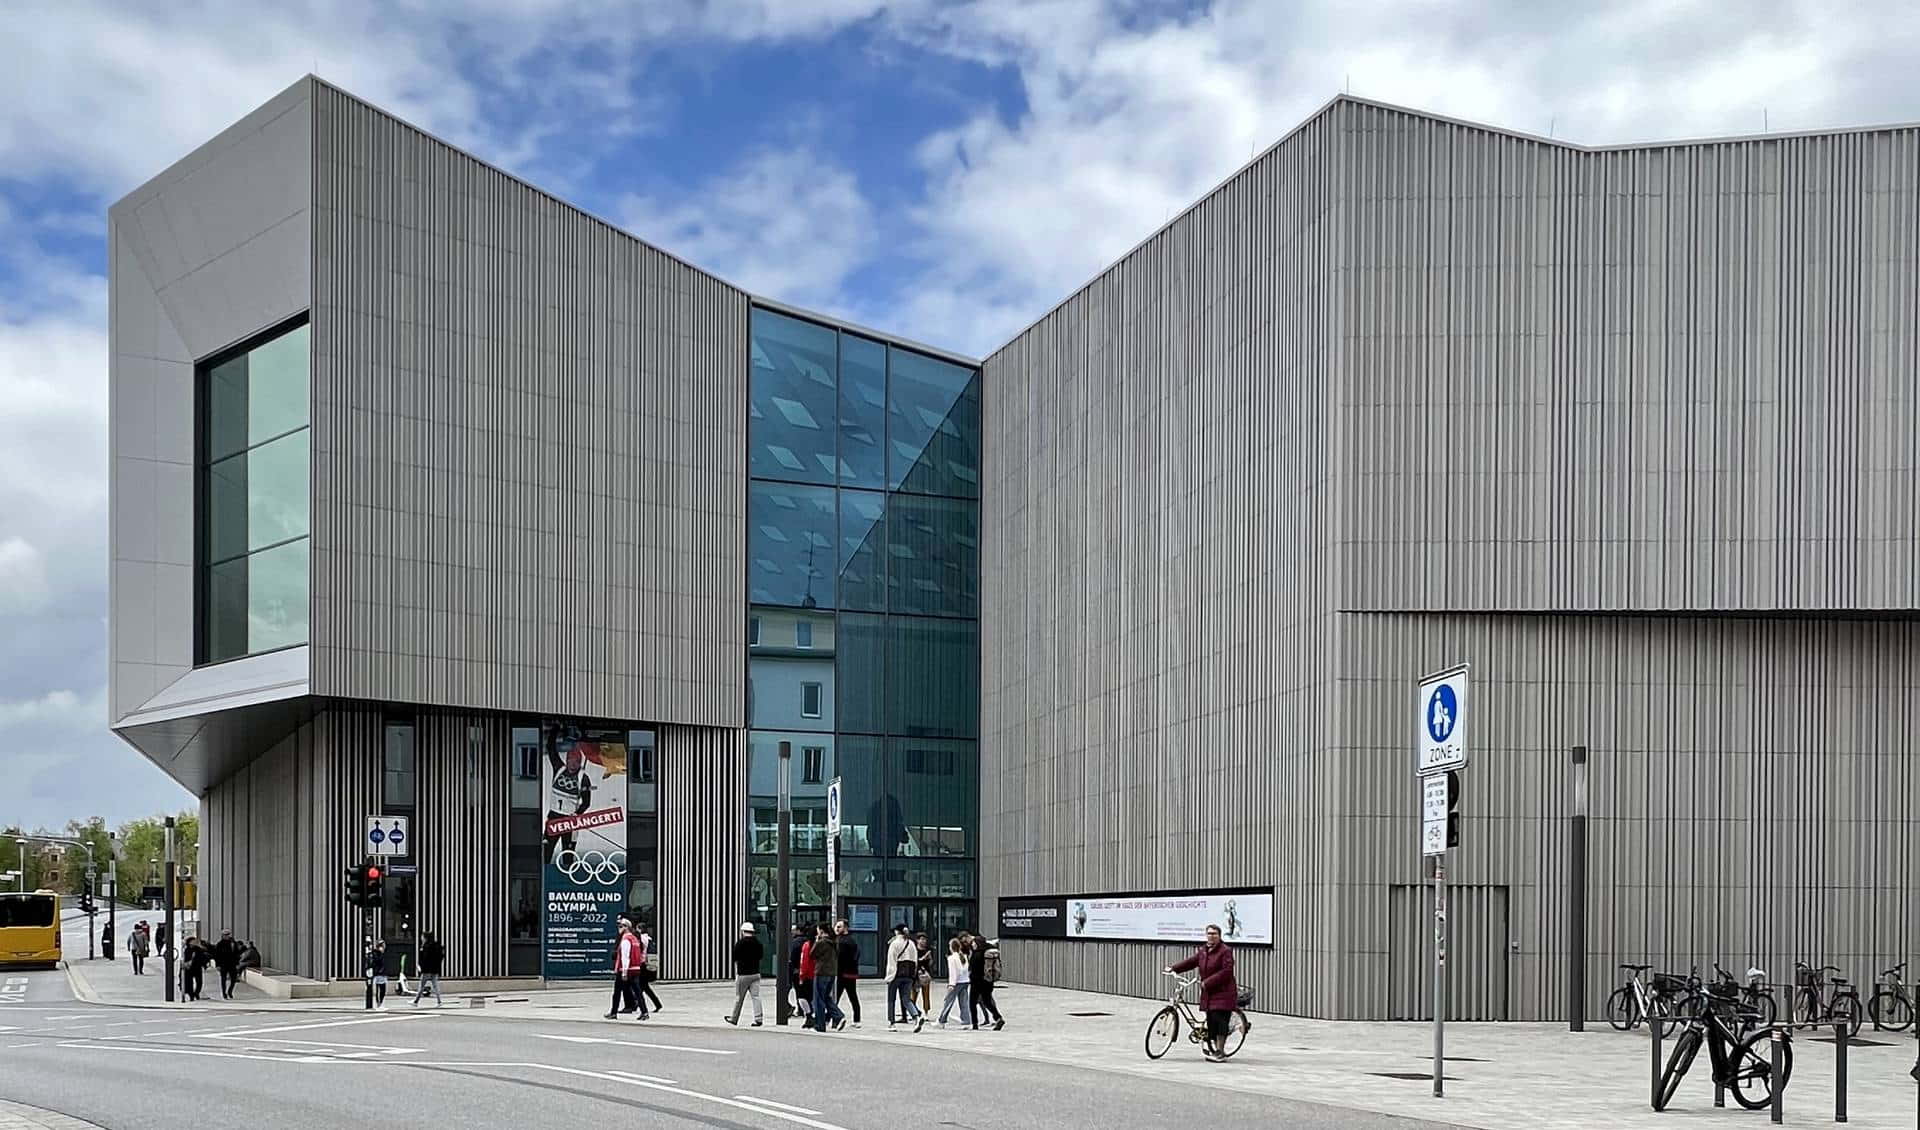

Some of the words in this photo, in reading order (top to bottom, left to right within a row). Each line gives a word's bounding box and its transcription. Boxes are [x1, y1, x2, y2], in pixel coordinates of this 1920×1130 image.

[1429, 744, 1453, 762] ZONE
[549, 811, 621, 833] VERLÄNGERT!
[548, 892, 595, 901] BAVARIA
[597, 893, 622, 902] UND
[548, 902, 597, 912] OLYMPIA
[548, 913, 573, 922] 1896
[582, 913, 607, 923] 2022
